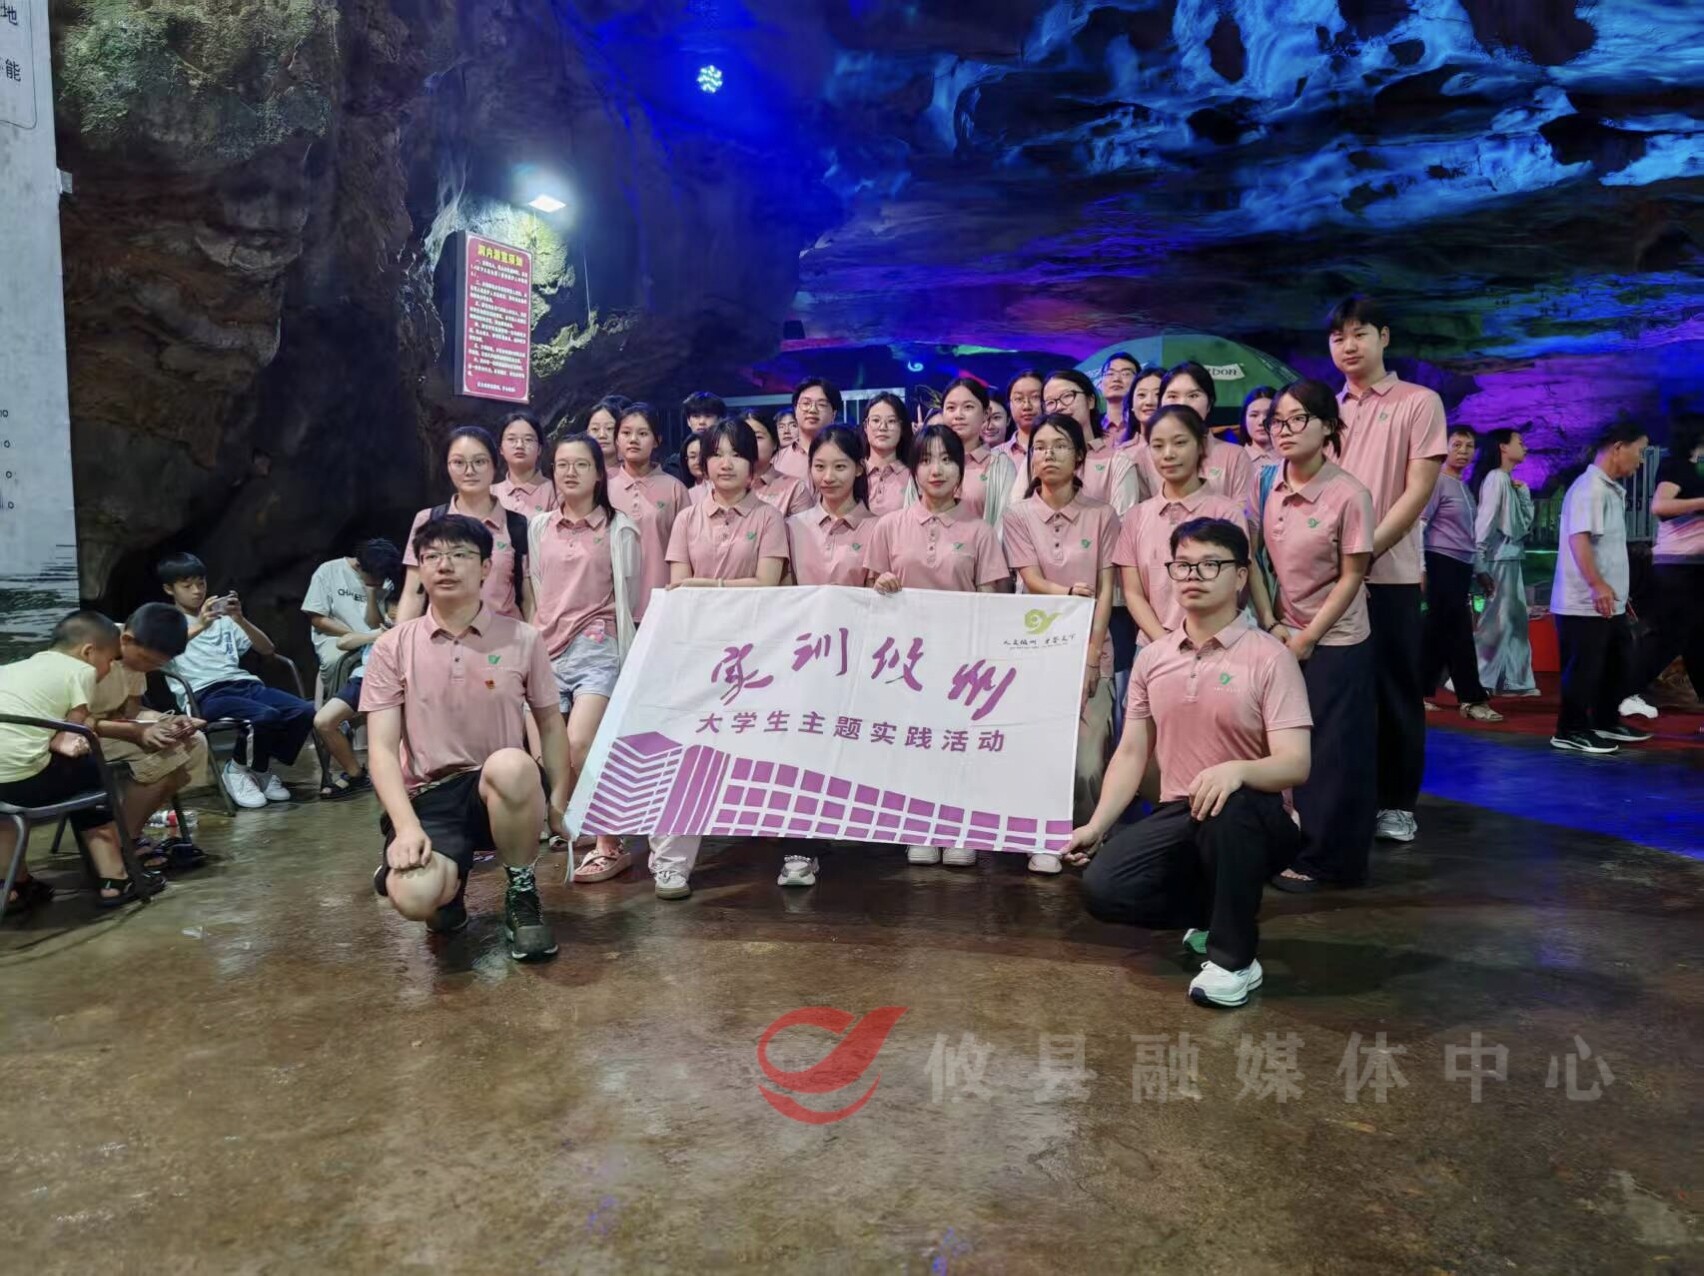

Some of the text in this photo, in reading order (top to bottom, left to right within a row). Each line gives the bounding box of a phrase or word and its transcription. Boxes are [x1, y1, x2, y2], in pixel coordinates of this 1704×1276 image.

[699, 711, 1005, 752] 大学生主题实践活动
